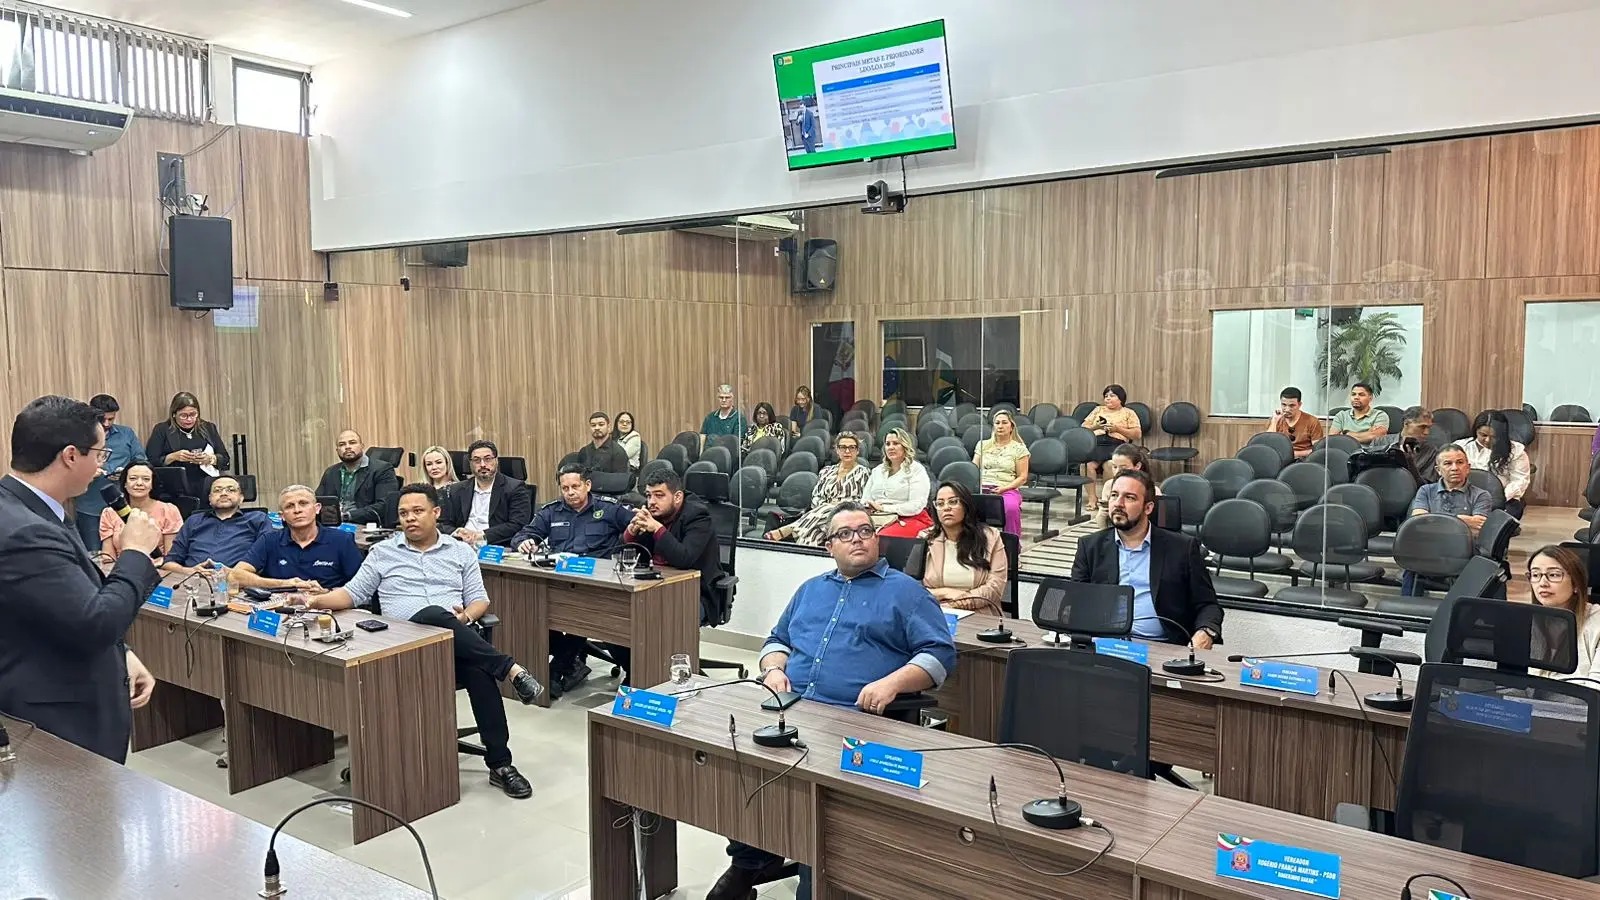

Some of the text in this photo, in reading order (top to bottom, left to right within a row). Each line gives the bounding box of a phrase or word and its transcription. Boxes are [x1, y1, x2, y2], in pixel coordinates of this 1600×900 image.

[861, 56, 880, 66] METAS
[886, 47, 924, 60] PRIORIDADES
[1284, 855, 1310, 866] VEREADOR
[1298, 867, 1319, 876] MARTINS
